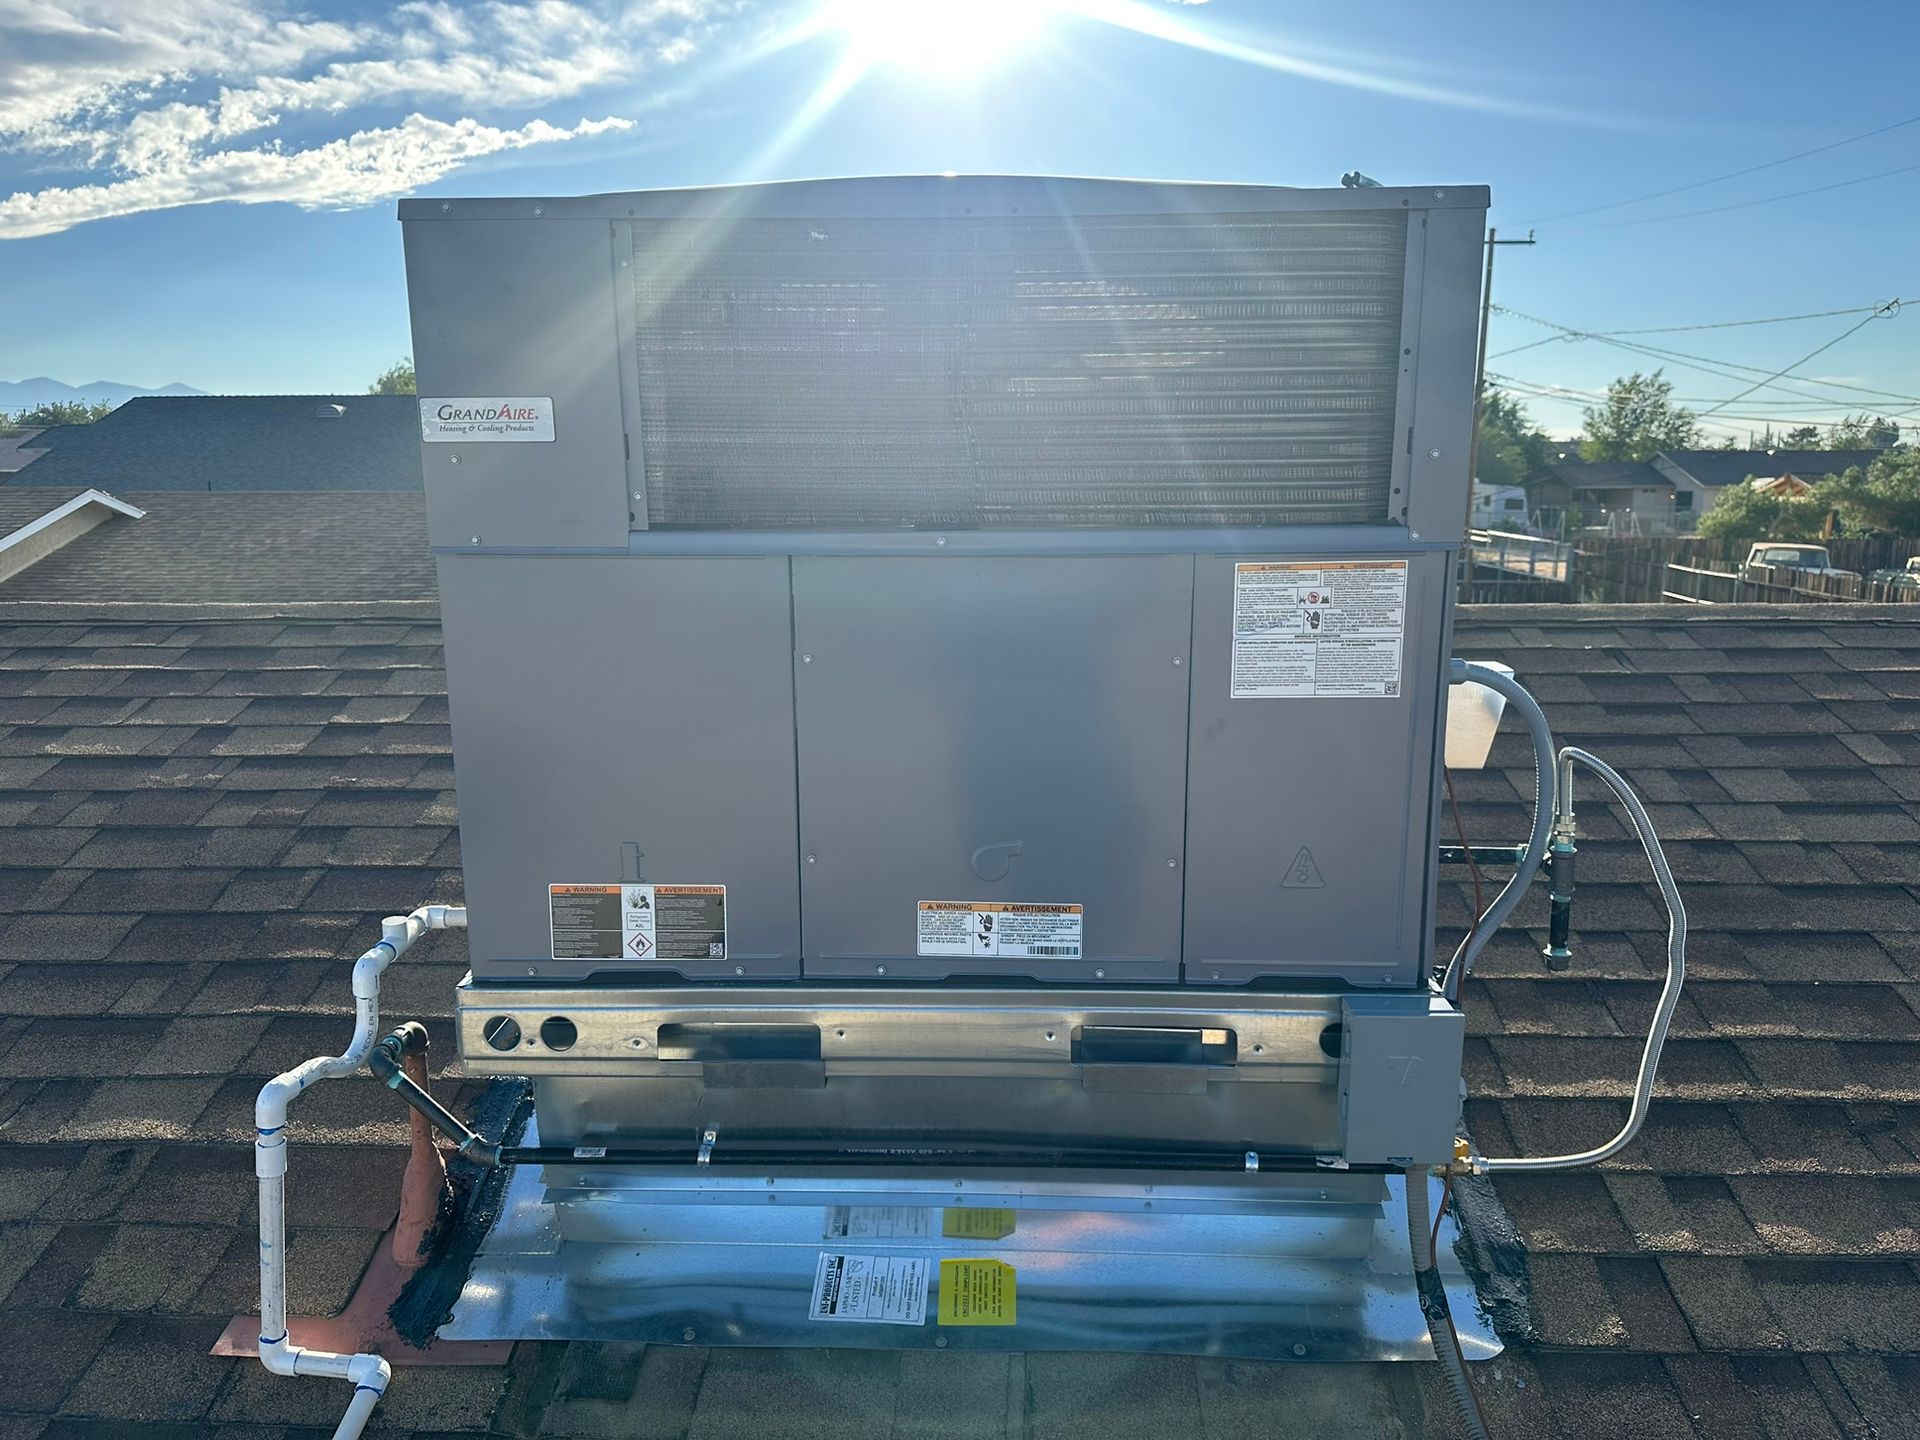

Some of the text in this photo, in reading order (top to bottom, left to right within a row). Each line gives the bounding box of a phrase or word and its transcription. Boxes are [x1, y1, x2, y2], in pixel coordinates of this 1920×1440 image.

[477, 424, 504, 434] Cooling
[362, 1030, 374, 1052] HECHO
[368, 1016, 374, 1026] EN
